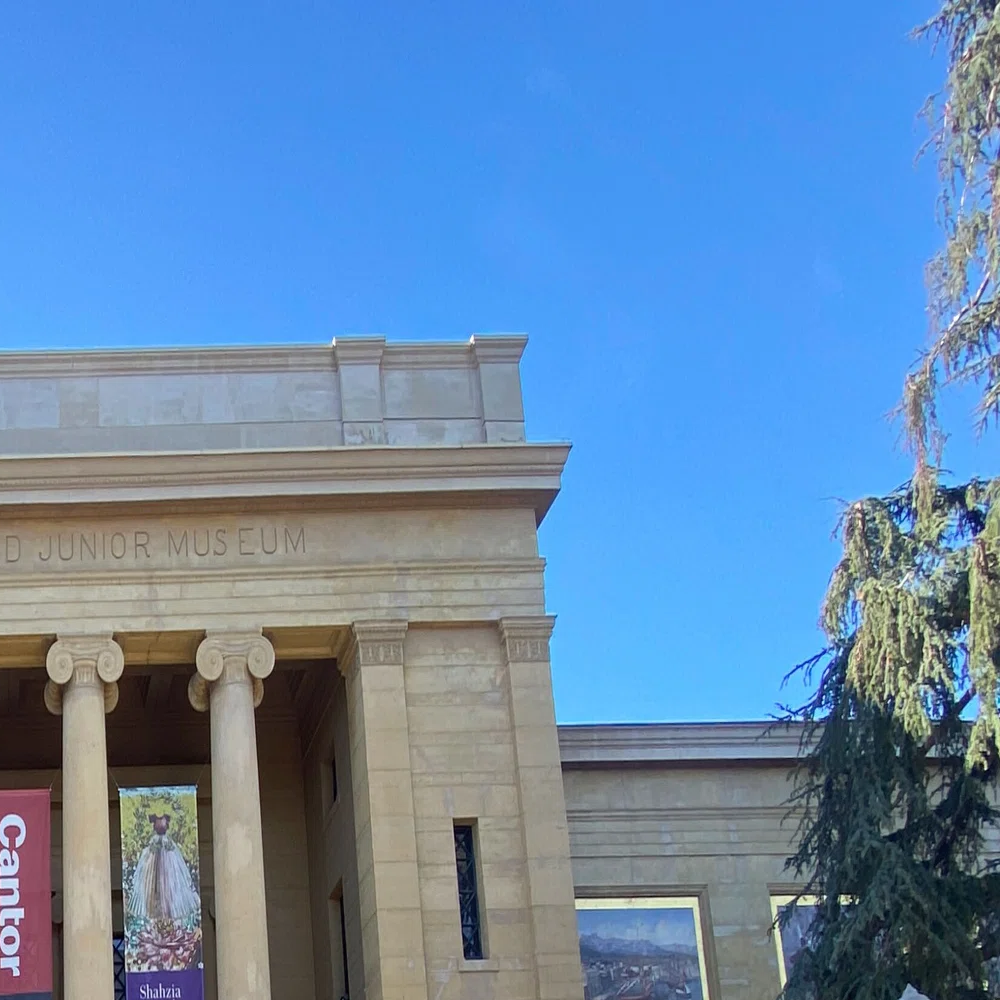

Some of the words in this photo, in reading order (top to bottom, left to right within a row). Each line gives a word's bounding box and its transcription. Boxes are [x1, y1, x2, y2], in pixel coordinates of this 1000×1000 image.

[38, 530, 151, 561] JUNIOR
[168, 526, 307, 558] MUSEUM
[140, 983, 181, 999] Shahzia
